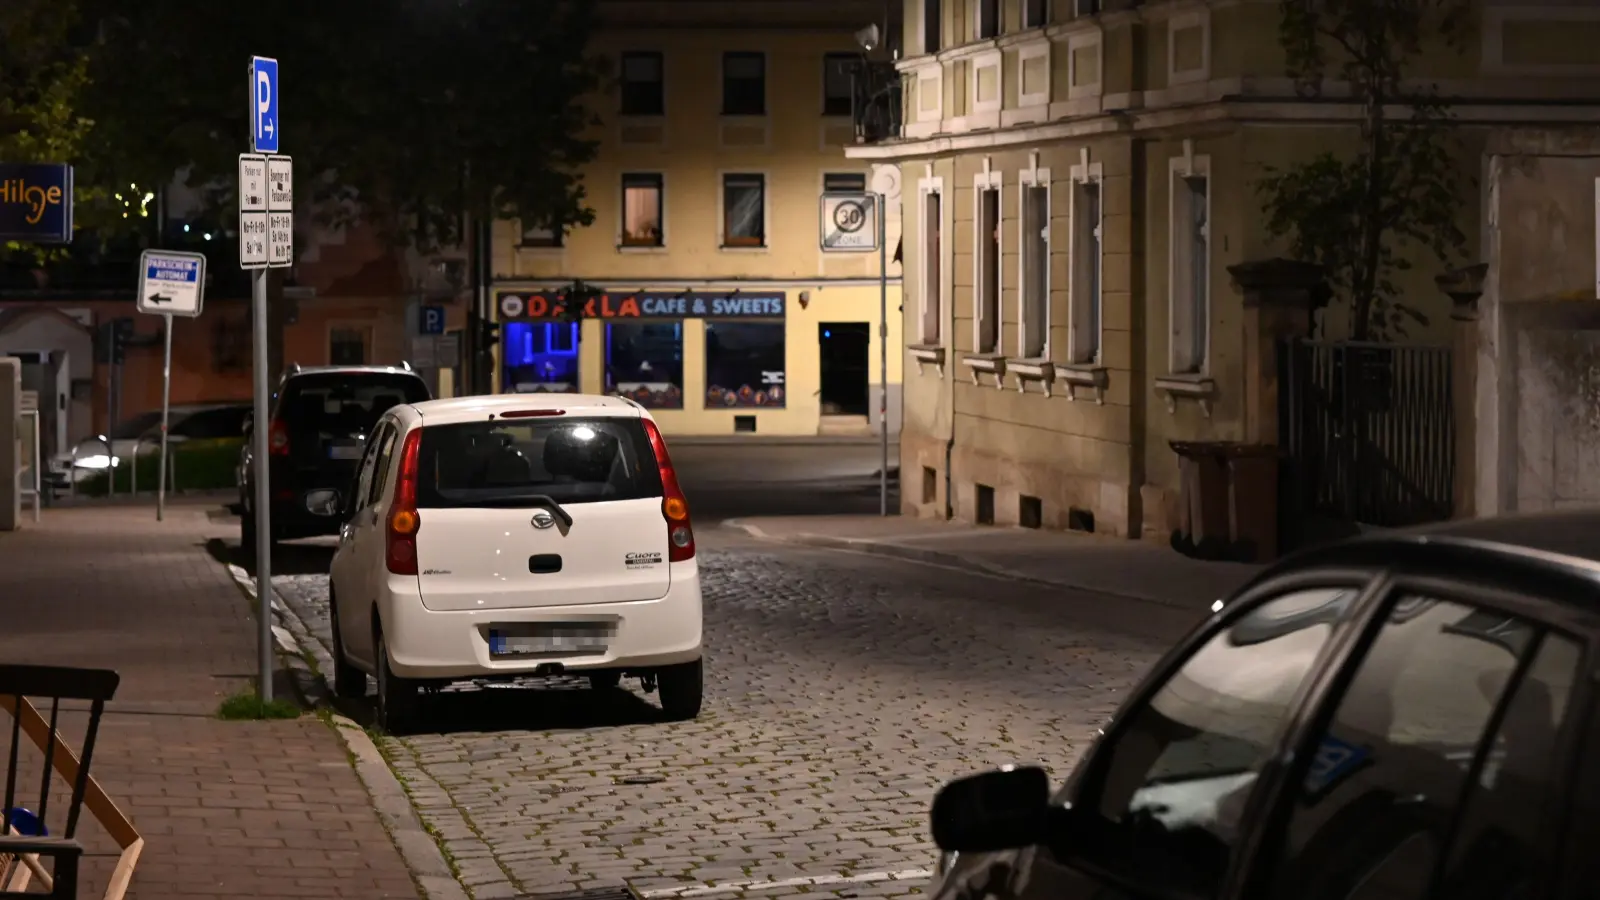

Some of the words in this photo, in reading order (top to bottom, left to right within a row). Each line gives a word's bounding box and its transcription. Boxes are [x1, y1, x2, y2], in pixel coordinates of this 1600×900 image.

[258, 70, 270, 139] P
[840, 209, 860, 225] 30
[246, 242, 252, 254] Sa
[156, 270, 188, 281] AUTOMAT
[642, 298, 686, 314] CAFE
[692, 298, 707, 314] &
[712, 298, 782, 314] SWEETS
[426, 309, 438, 331] P
[625, 552, 661, 560] Cuore
